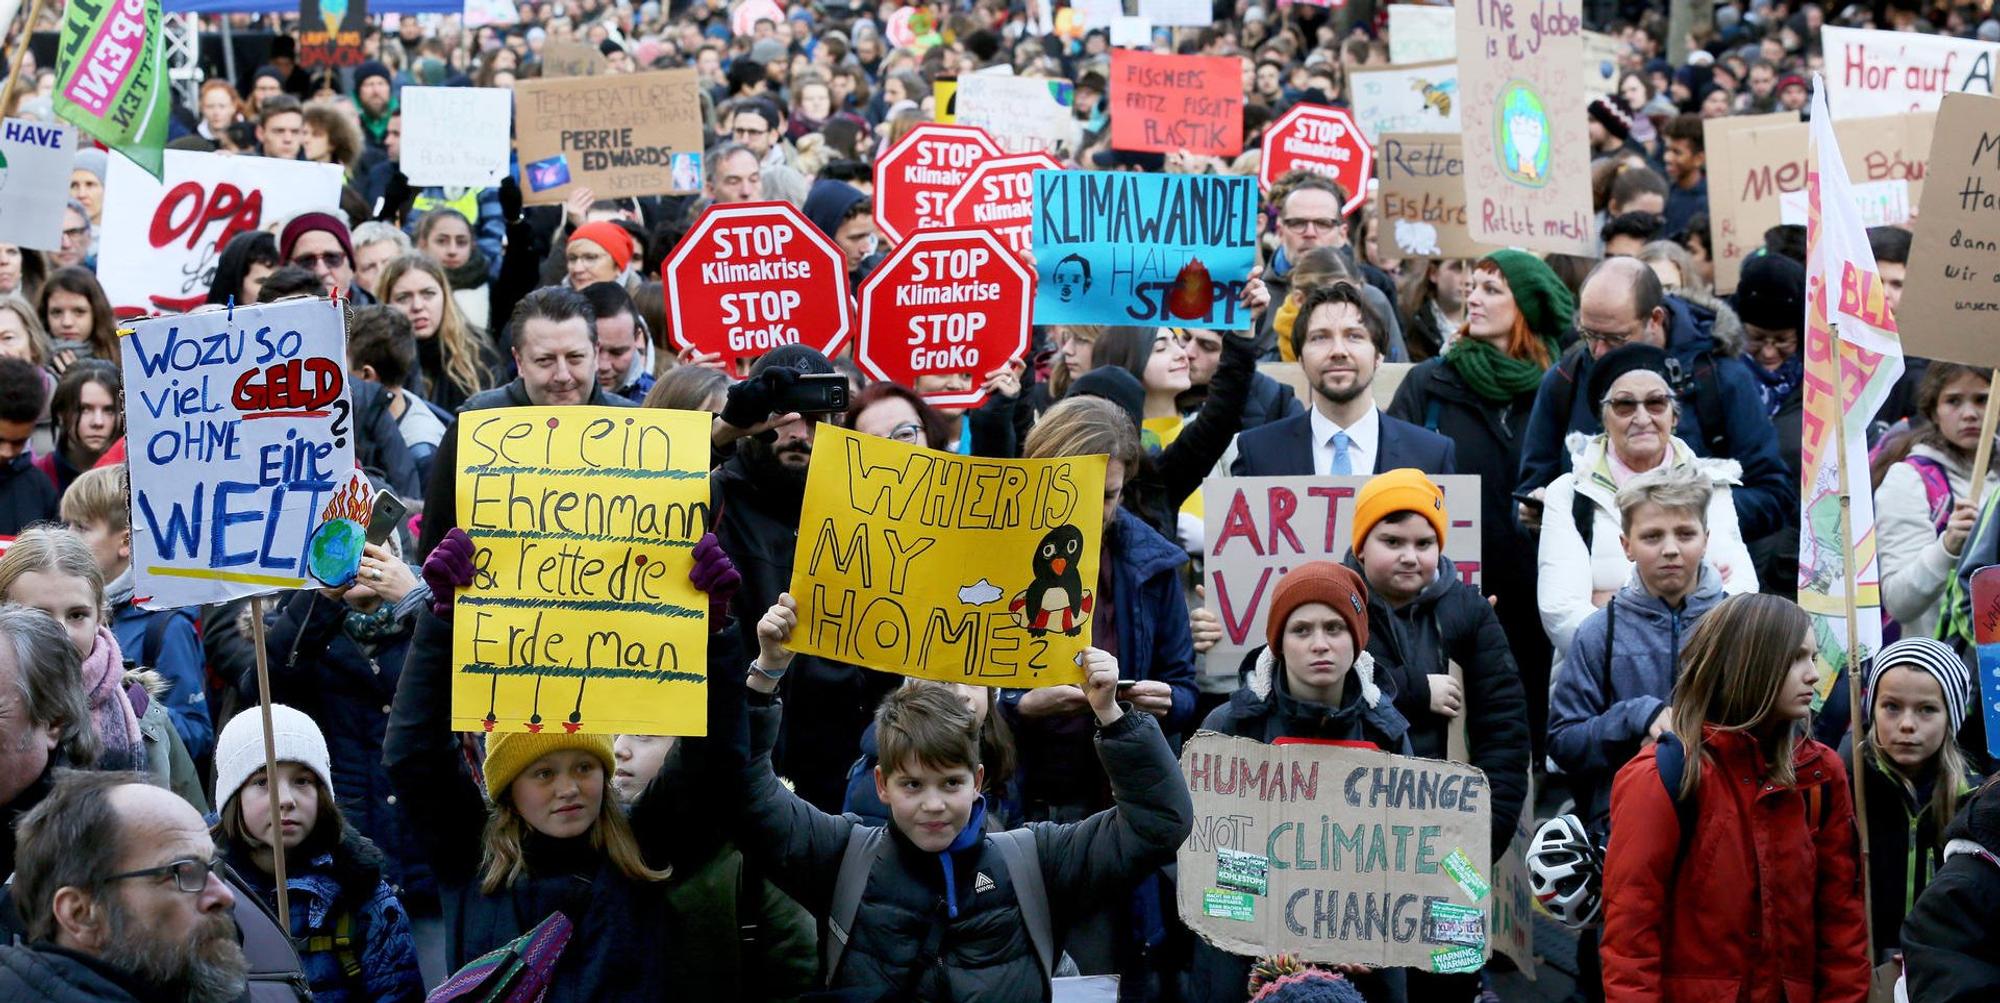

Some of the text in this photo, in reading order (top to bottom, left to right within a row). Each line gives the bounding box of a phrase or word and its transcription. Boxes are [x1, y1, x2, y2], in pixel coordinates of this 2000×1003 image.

[1526, 0, 1580, 53] globe
[528, 82, 697, 114] TEMPERATURES
[1126, 92, 1167, 113] FRITZ
[6, 122, 63, 149] HAVE
[561, 128, 634, 151] PERRIE
[1294, 117, 1347, 144] STOP
[583, 146, 672, 171] EDWARDS
[917, 141, 983, 168] STOP
[905, 165, 968, 186] Klimak
[982, 172, 1032, 202] STO
[149, 181, 264, 254] OPA
[915, 191, 949, 216] ST
[1040, 174, 1256, 248] KLIMAWANDEL
[712, 224, 794, 259] STOP
[701, 259, 811, 285] Klimakrise
[911, 248, 990, 282] STOP
[719, 290, 801, 325] STOP
[896, 281, 1000, 306] Klimakrise
[1126, 280, 1248, 325] STPP
[728, 324, 799, 351] GroKo
[908, 312, 987, 346] STOP
[910, 347, 979, 371] GroKo
[231, 357, 344, 412] GELD
[147, 419, 243, 466] OHNE
[580, 417, 670, 470] ein
[471, 473, 711, 540] Ehrenmann
[137, 481, 338, 579] WELT
[809, 517, 936, 595] MY
[809, 583, 1050, 679] HOME?
[586, 630, 678, 671] man
[1190, 752, 1486, 813] HUMAN CHANGE
[1188, 814, 1254, 853] NOT
[1284, 887, 1451, 945] CHANGE
[1433, 946, 1477, 963] WARNING
[1437, 953, 1483, 971] WARMING!
